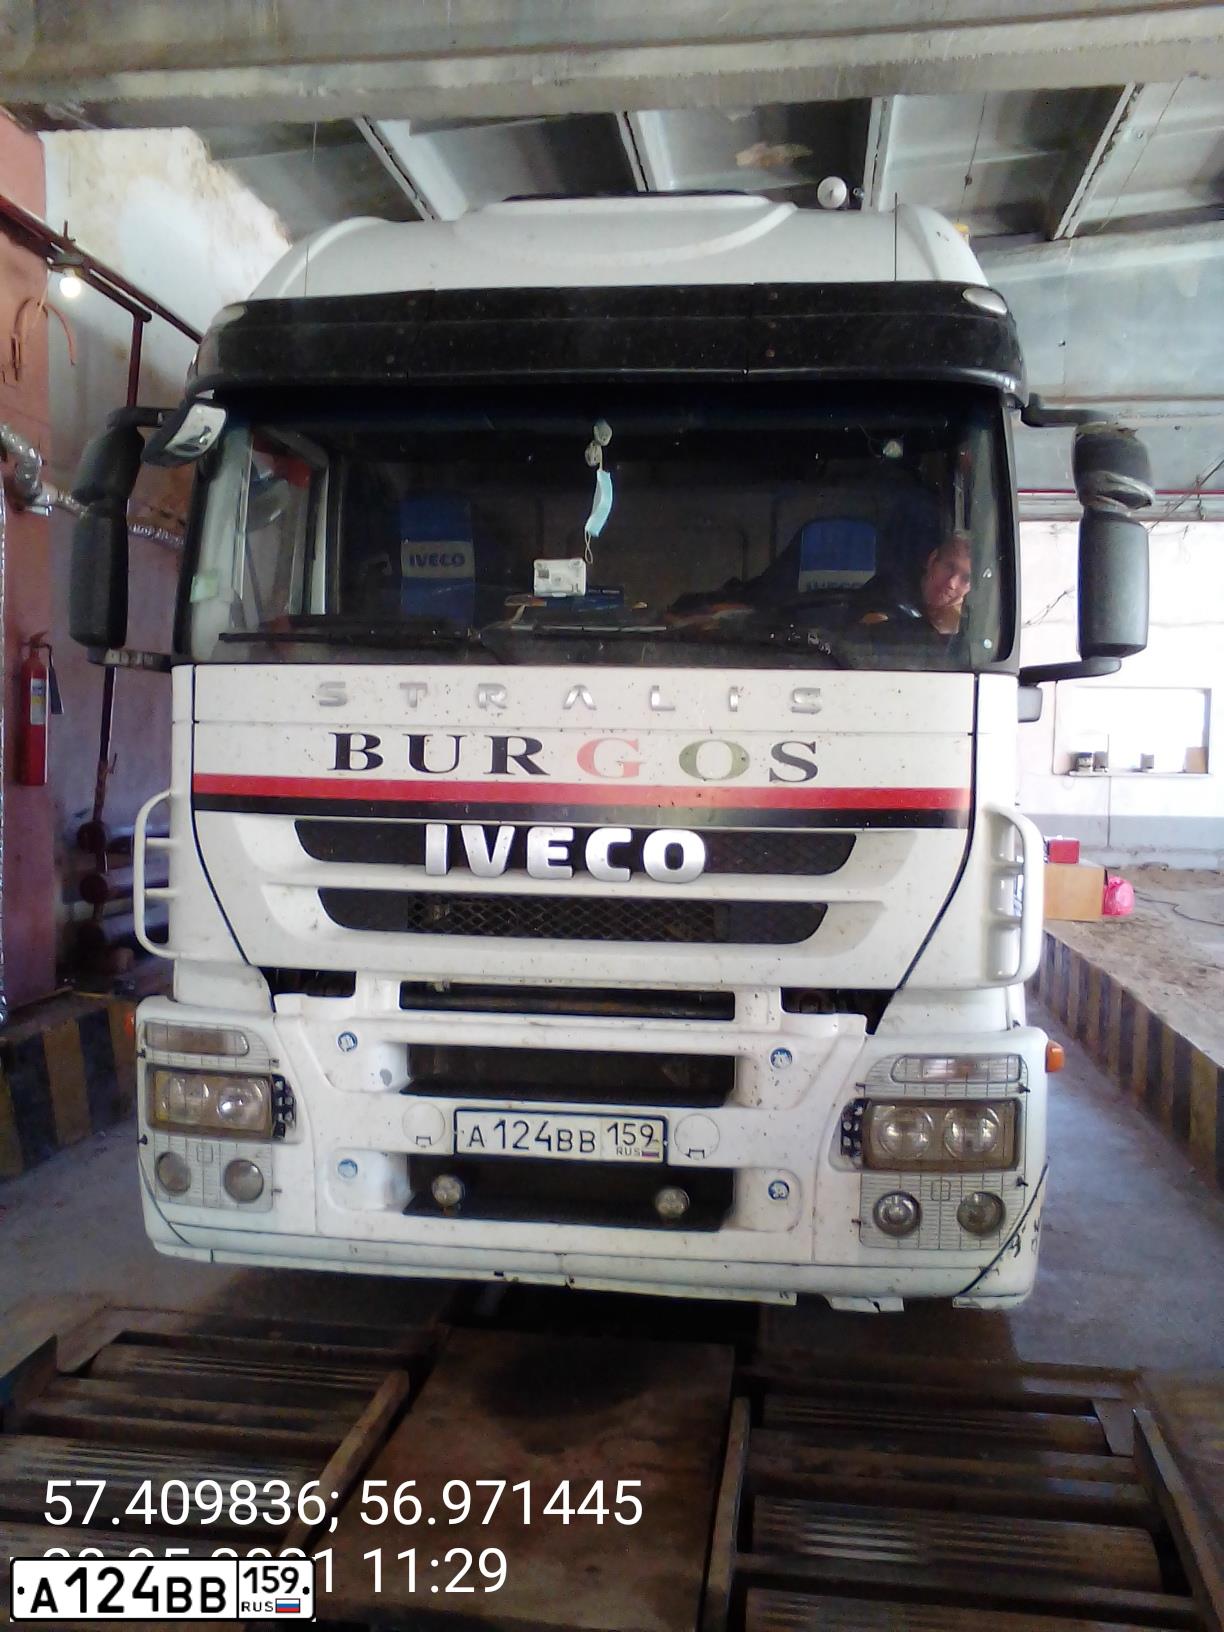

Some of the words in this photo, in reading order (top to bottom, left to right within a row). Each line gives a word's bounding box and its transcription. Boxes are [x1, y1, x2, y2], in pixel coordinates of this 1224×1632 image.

[409, 552, 466, 568] IVECO
[317, 680, 823, 715] STRALIS
[328, 731, 819, 783] BURGOS
[425, 823, 706, 883] IVECO
[607, 1122, 654, 1147] 159
[616, 1147, 640, 1156] RUS
